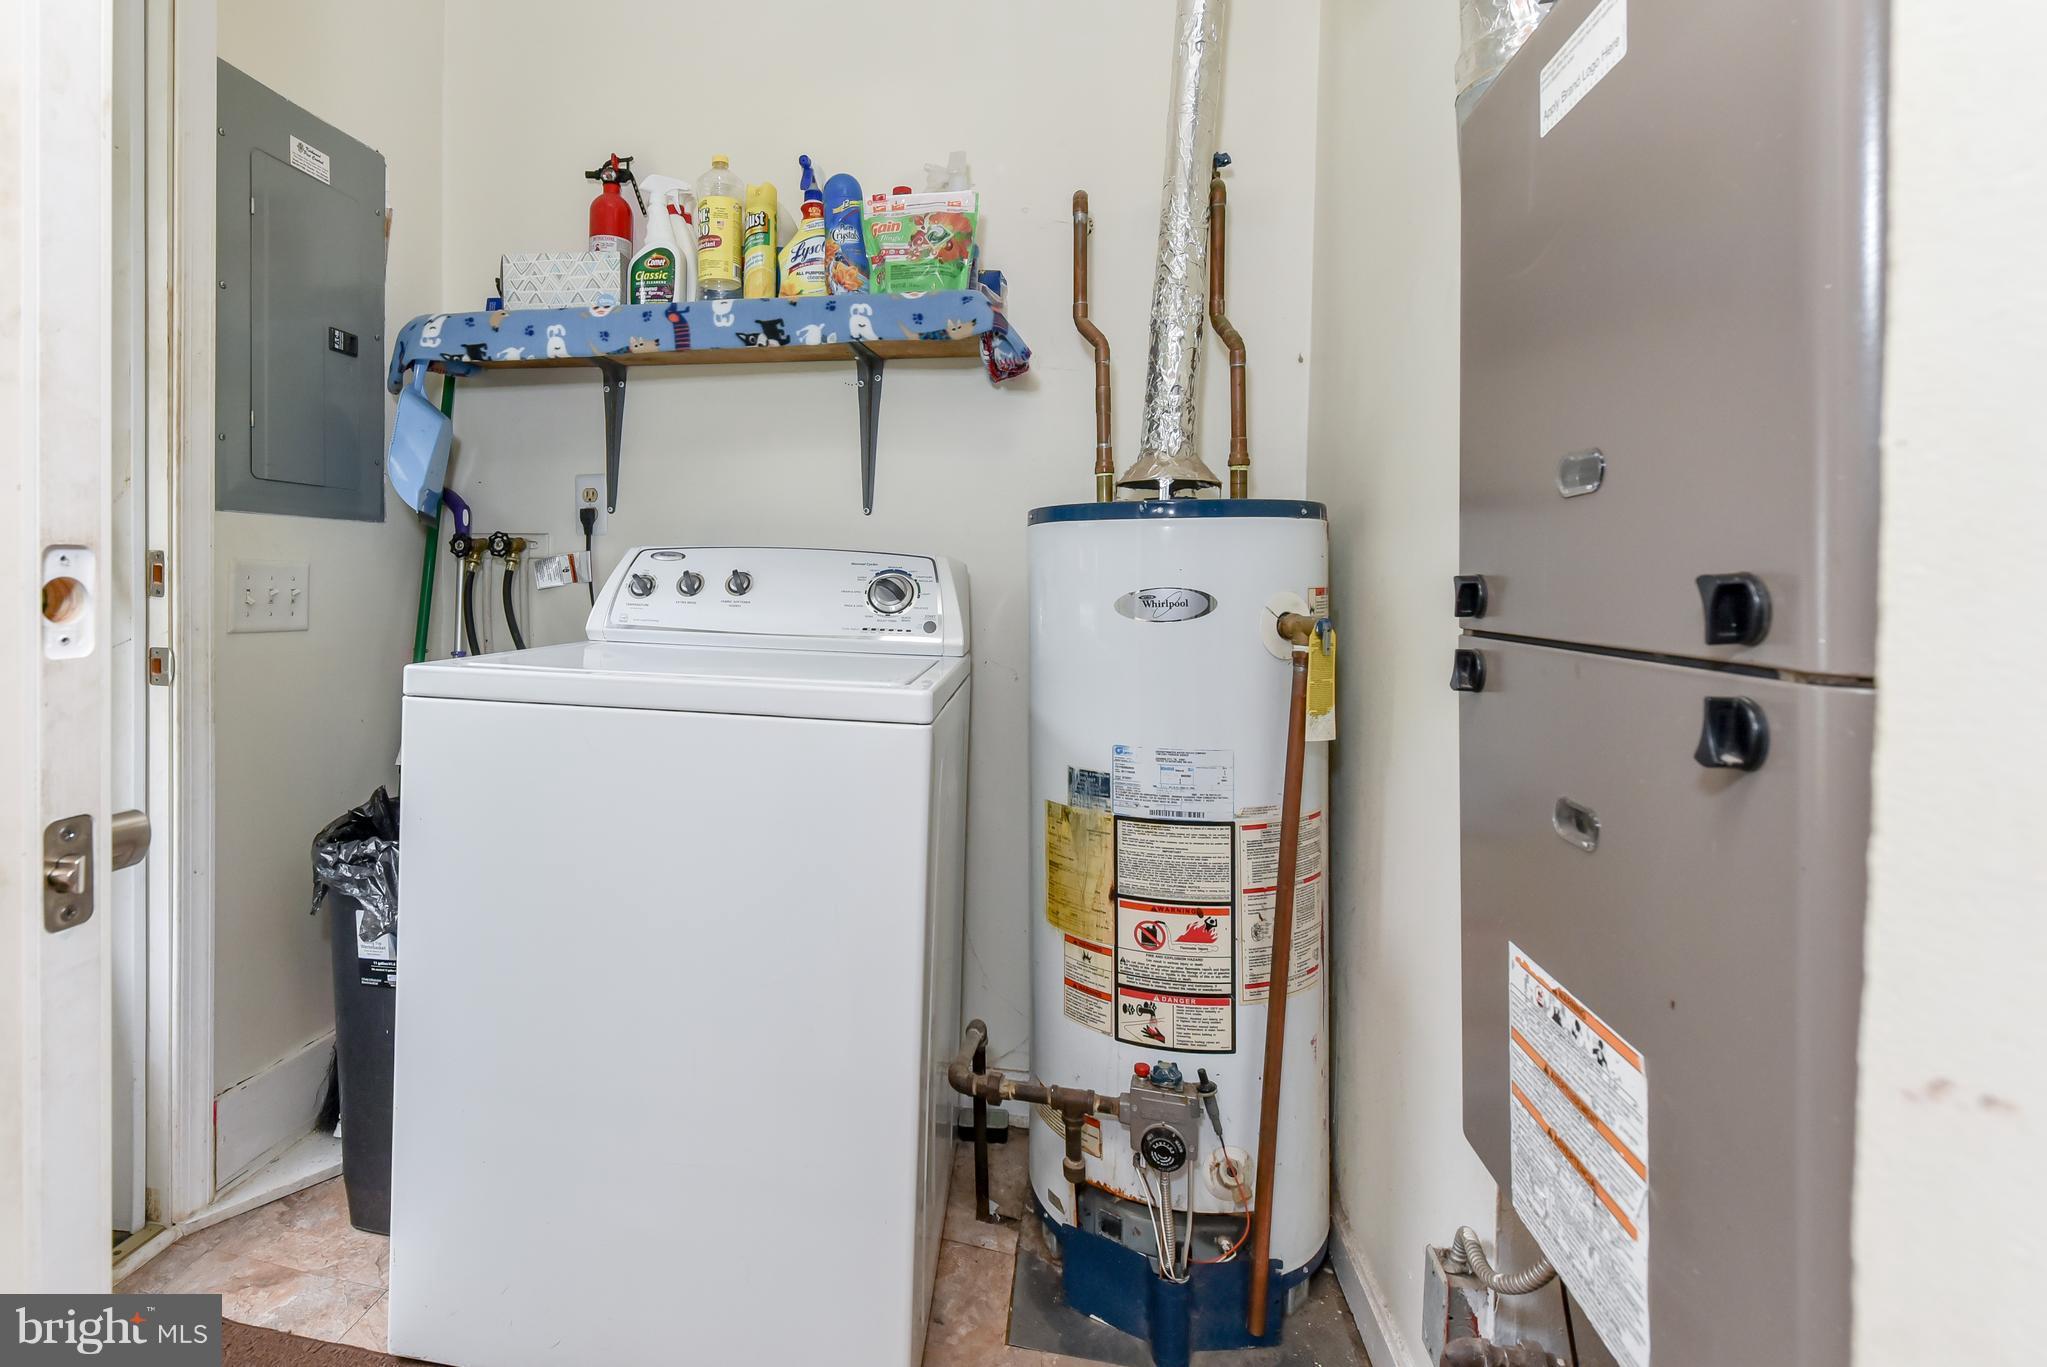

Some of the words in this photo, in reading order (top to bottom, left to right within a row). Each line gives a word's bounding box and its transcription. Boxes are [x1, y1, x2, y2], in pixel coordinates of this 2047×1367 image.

[872, 222, 902, 237] Gain
[791, 238, 825, 262] Lysol
[648, 258, 666, 267] Comet
[635, 271, 669, 281] Classic
[1142, 599, 1189, 610] Whirlpool
[1156, 906, 1199, 915] WARNING
[1161, 996, 1197, 1005] DANGER
